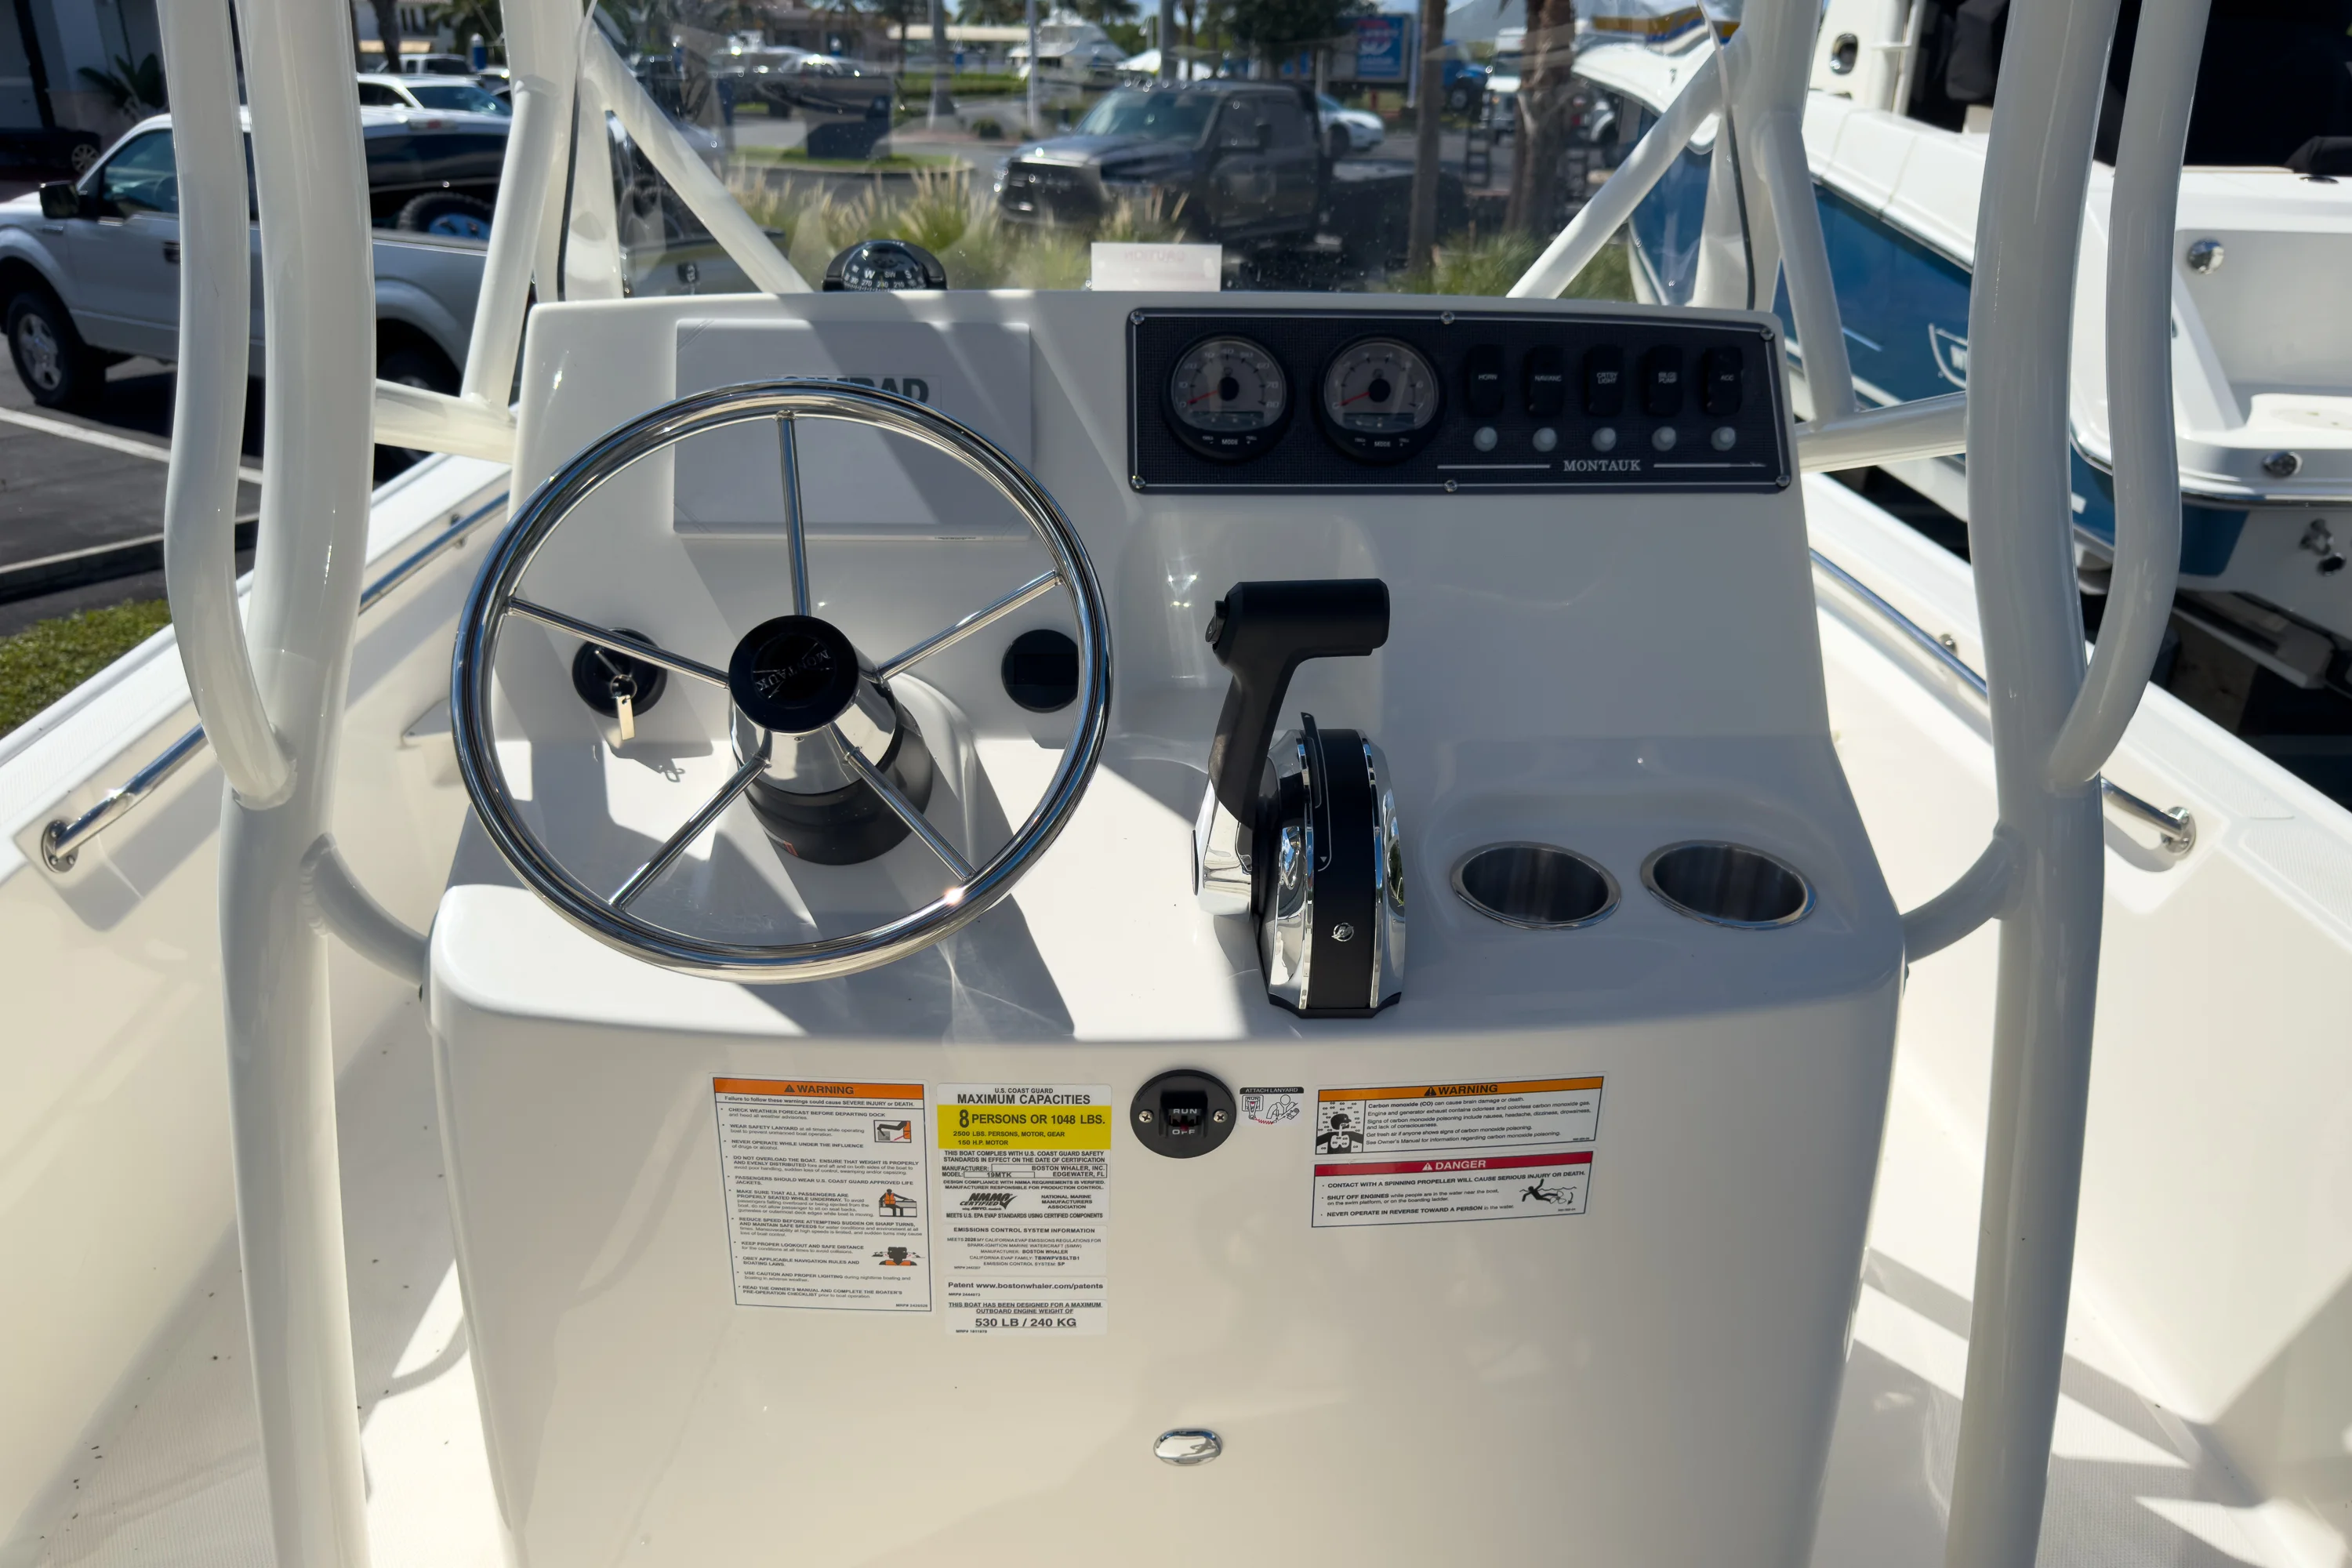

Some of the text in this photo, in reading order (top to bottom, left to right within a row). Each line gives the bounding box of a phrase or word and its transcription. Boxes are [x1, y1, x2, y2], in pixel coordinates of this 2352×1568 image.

[865, 270, 875, 279] W
[904, 270, 912, 279] S
[1564, 460, 1641, 472] MONTAUK
[797, 1085, 854, 1095] WARNING
[1438, 1084, 1498, 1095] WARNING
[957, 1095, 1090, 1104] MAXIMUM CAPACITIES
[959, 1109, 1105, 1128] 8 PERSONS OR 1048 LBS.
[1435, 1160, 1486, 1170] DANGER
[969, 1193, 1010, 1201] NMMA
